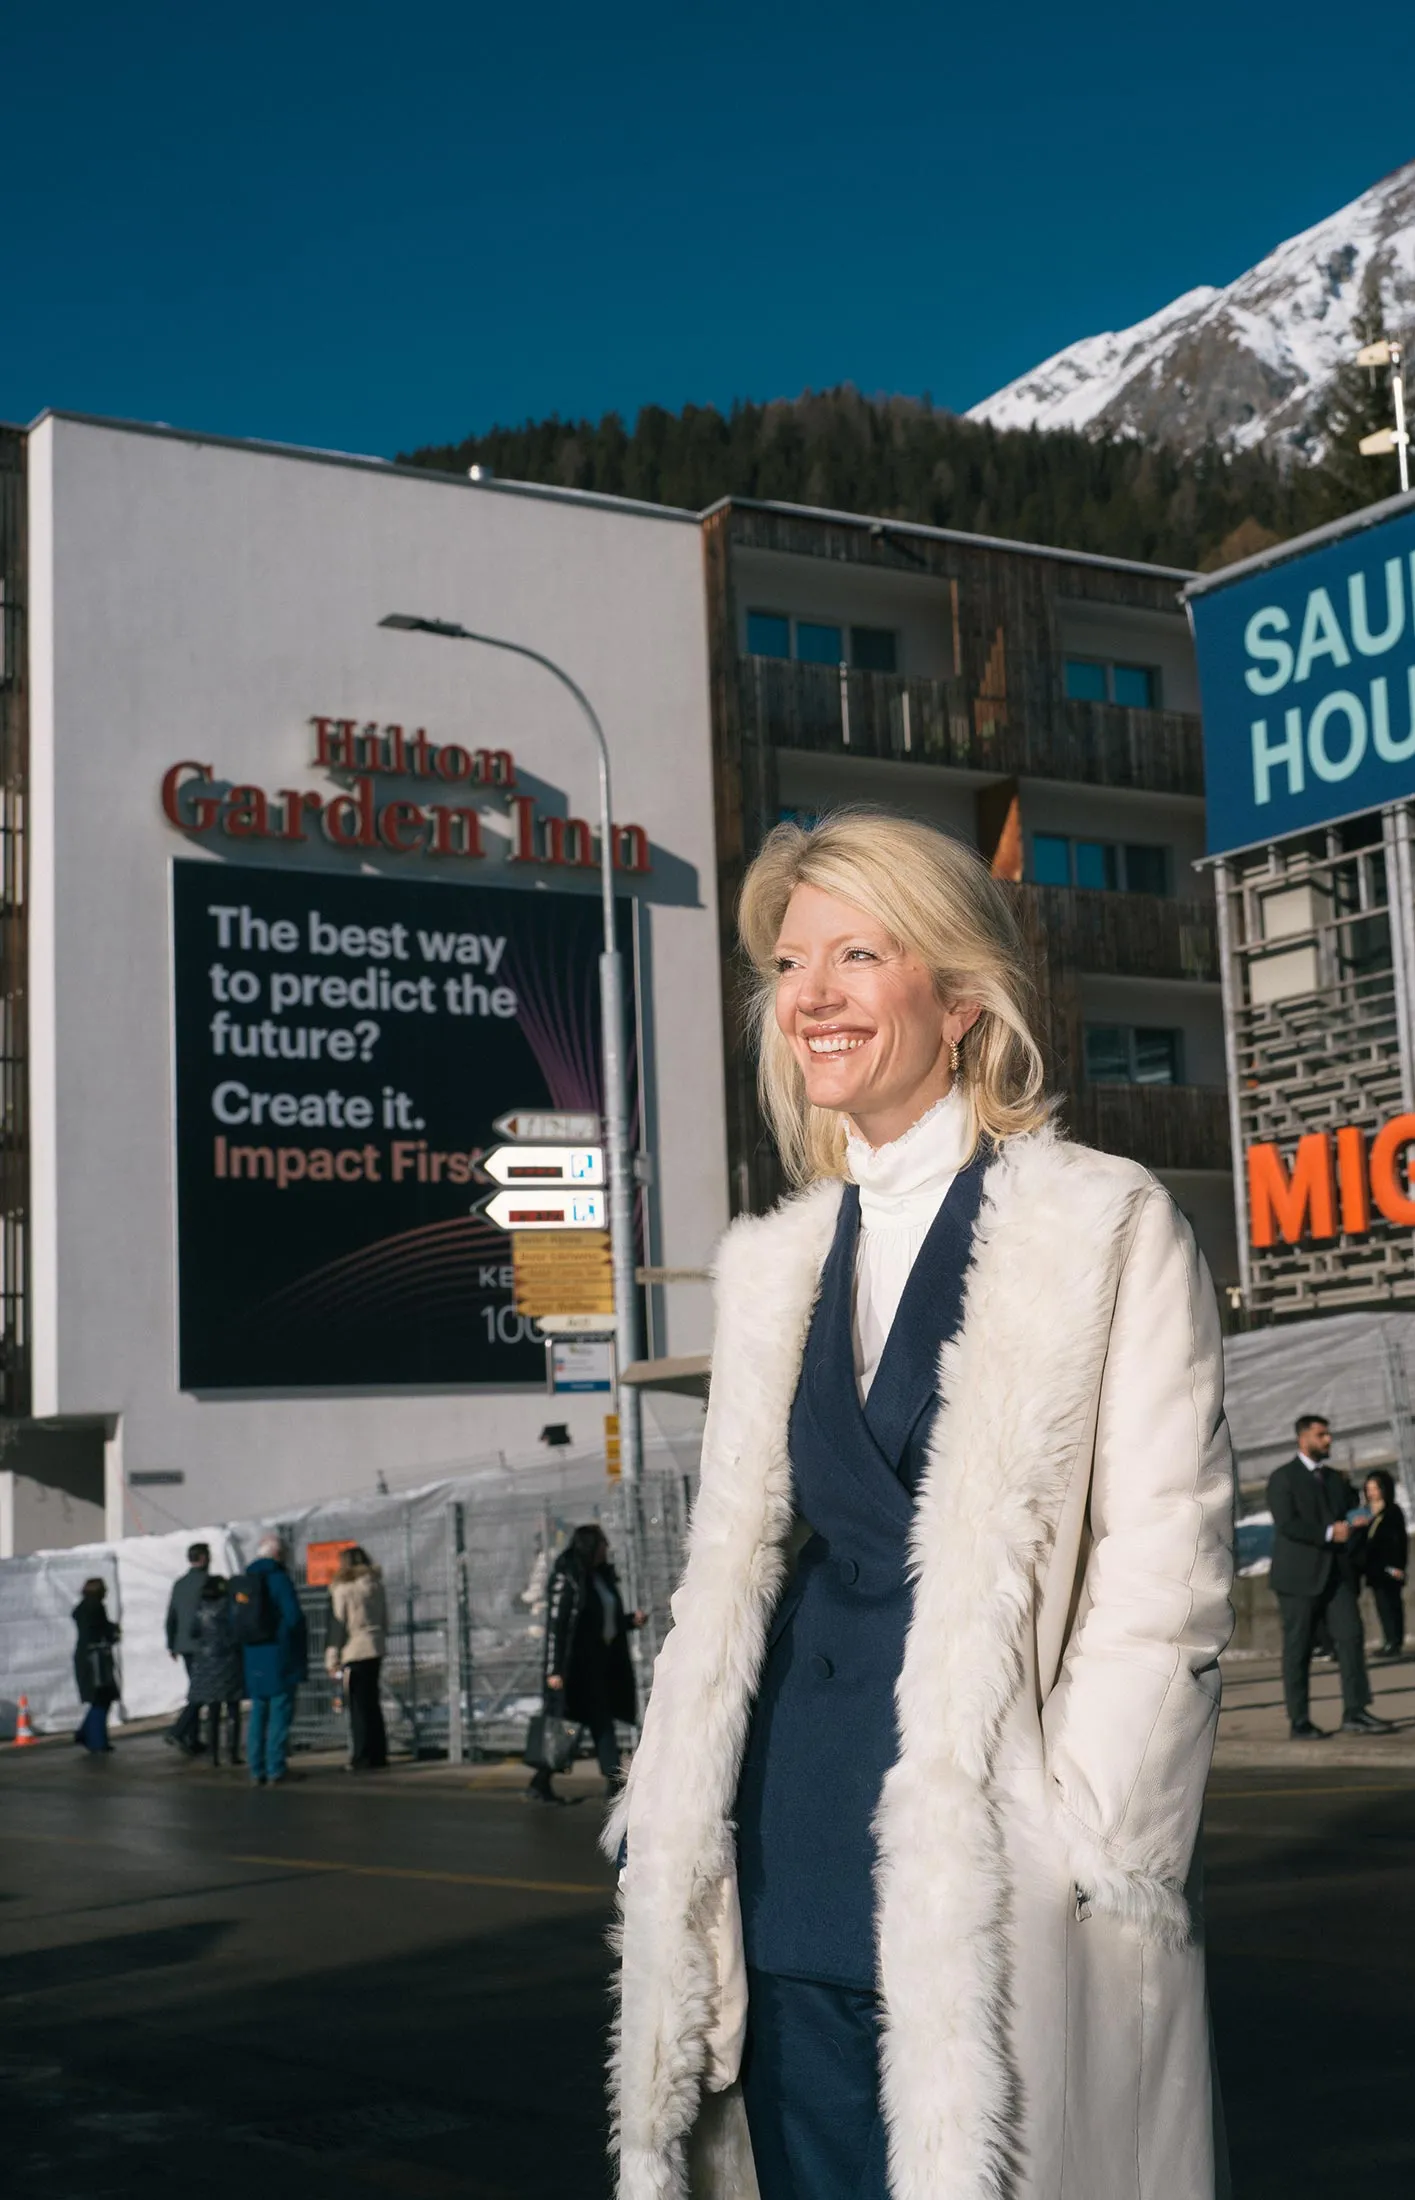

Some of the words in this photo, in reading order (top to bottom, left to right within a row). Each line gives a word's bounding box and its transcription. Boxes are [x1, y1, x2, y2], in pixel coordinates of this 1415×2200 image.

[1244, 549, 1415, 696] SAU
[309, 715, 518, 788] Hilton
[1251, 665, 1415, 806] HOU
[160, 760, 487, 859] Garden
[508, 794, 653, 872] Inn
[208, 905, 300, 951] The
[309, 910, 409, 960] best
[418, 930, 507, 974] way
[208, 963, 261, 1003] to
[270, 966, 437, 1014] predict
[443, 973, 518, 1018] the
[210, 1010, 381, 1063] future?
[211, 1080, 374, 1129] Create
[382, 1086, 426, 1130] it.
[214, 1136, 381, 1189] Impact
